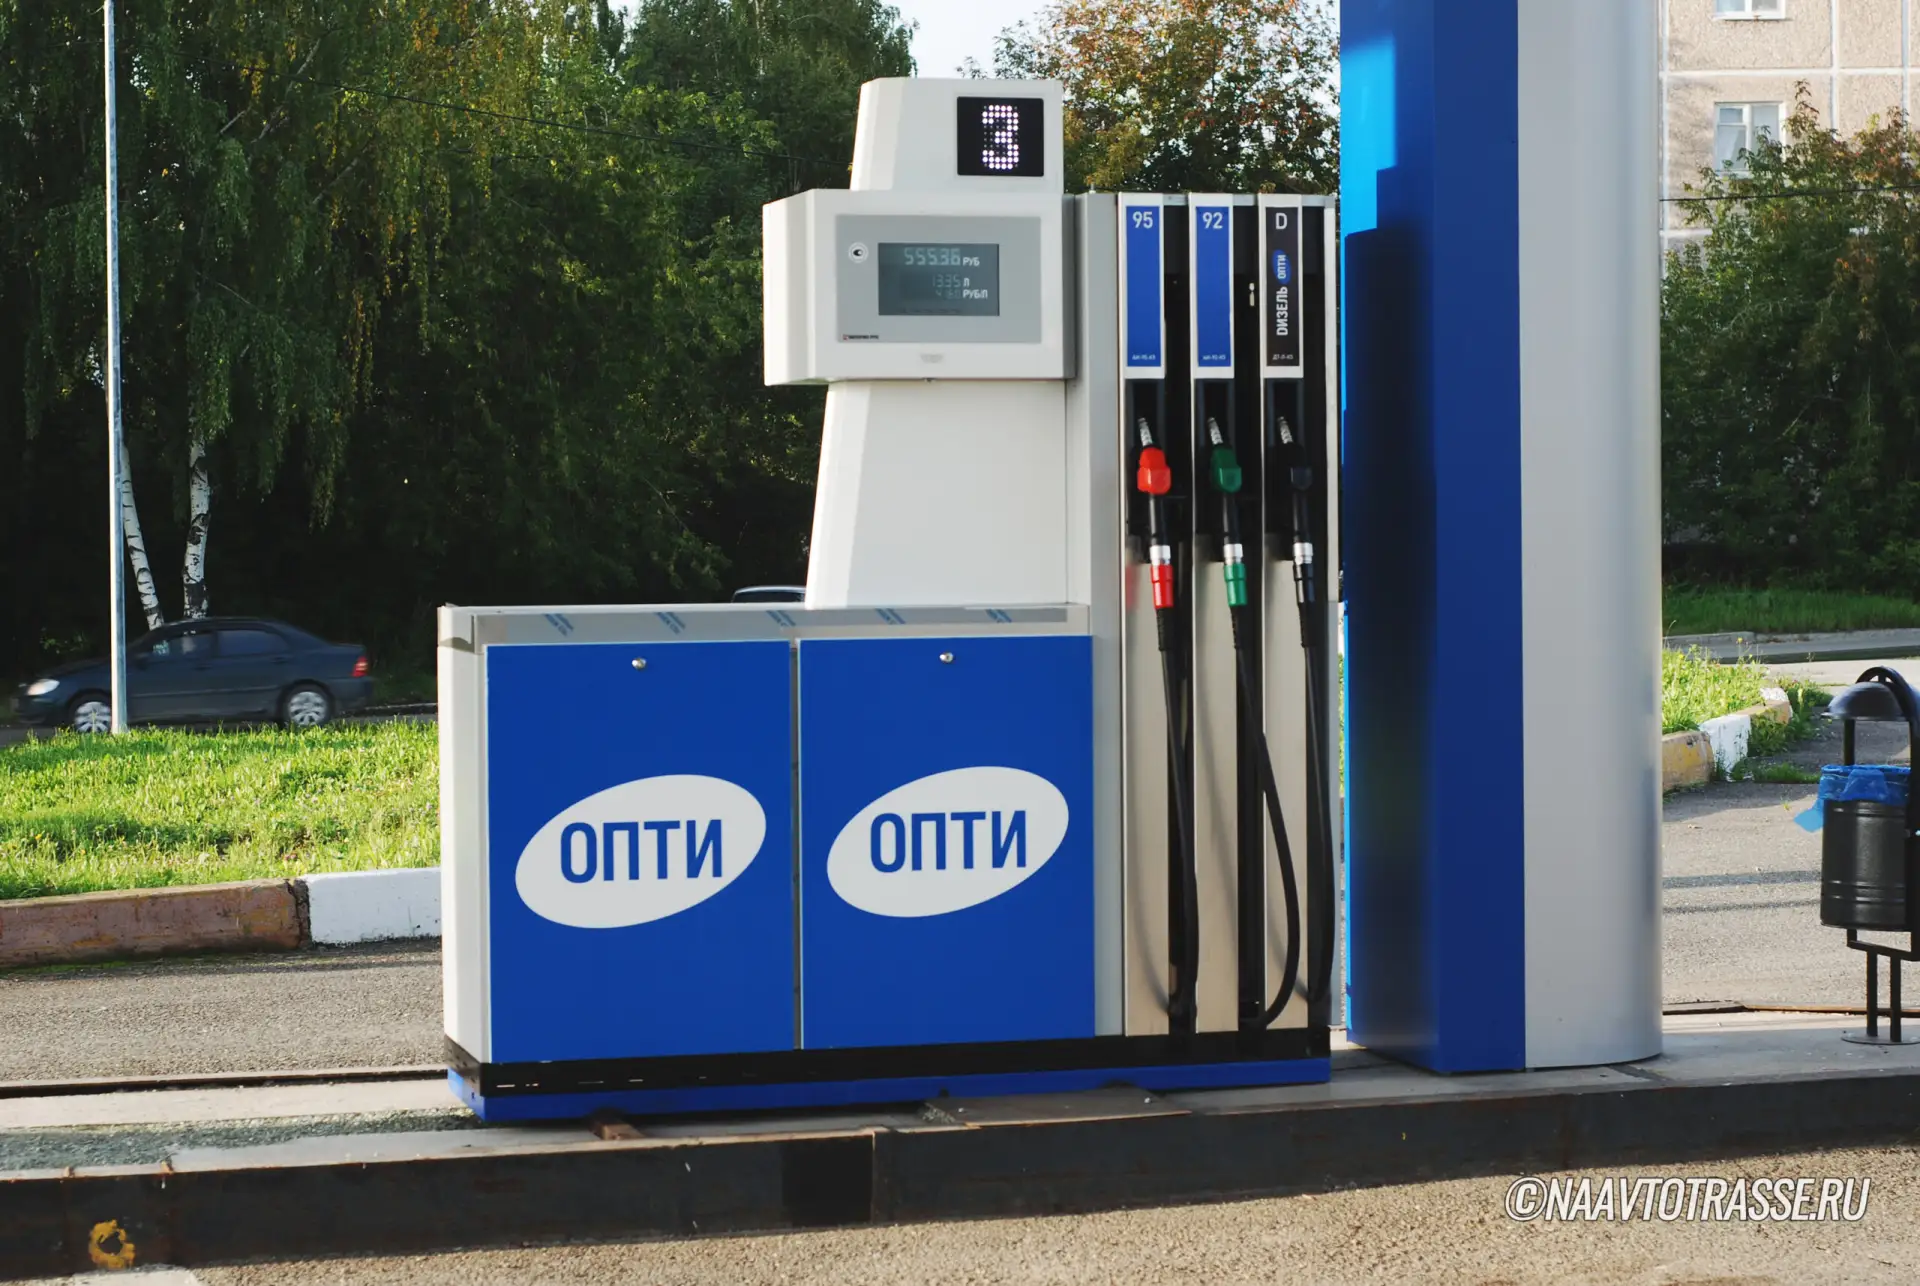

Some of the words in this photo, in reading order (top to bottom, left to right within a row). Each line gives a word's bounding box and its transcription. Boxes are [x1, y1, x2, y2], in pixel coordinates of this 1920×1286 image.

[982, 104, 1019, 170] 3
[1132, 211, 1154, 229] 95
[1202, 211, 1224, 230] 92
[1275, 212, 1288, 230] D
[962, 256, 981, 267] РУБ
[1277, 254, 1287, 280] ОПТИ
[559, 819, 723, 883] ОПТИ
[869, 810, 1027, 873] ОПТИ
